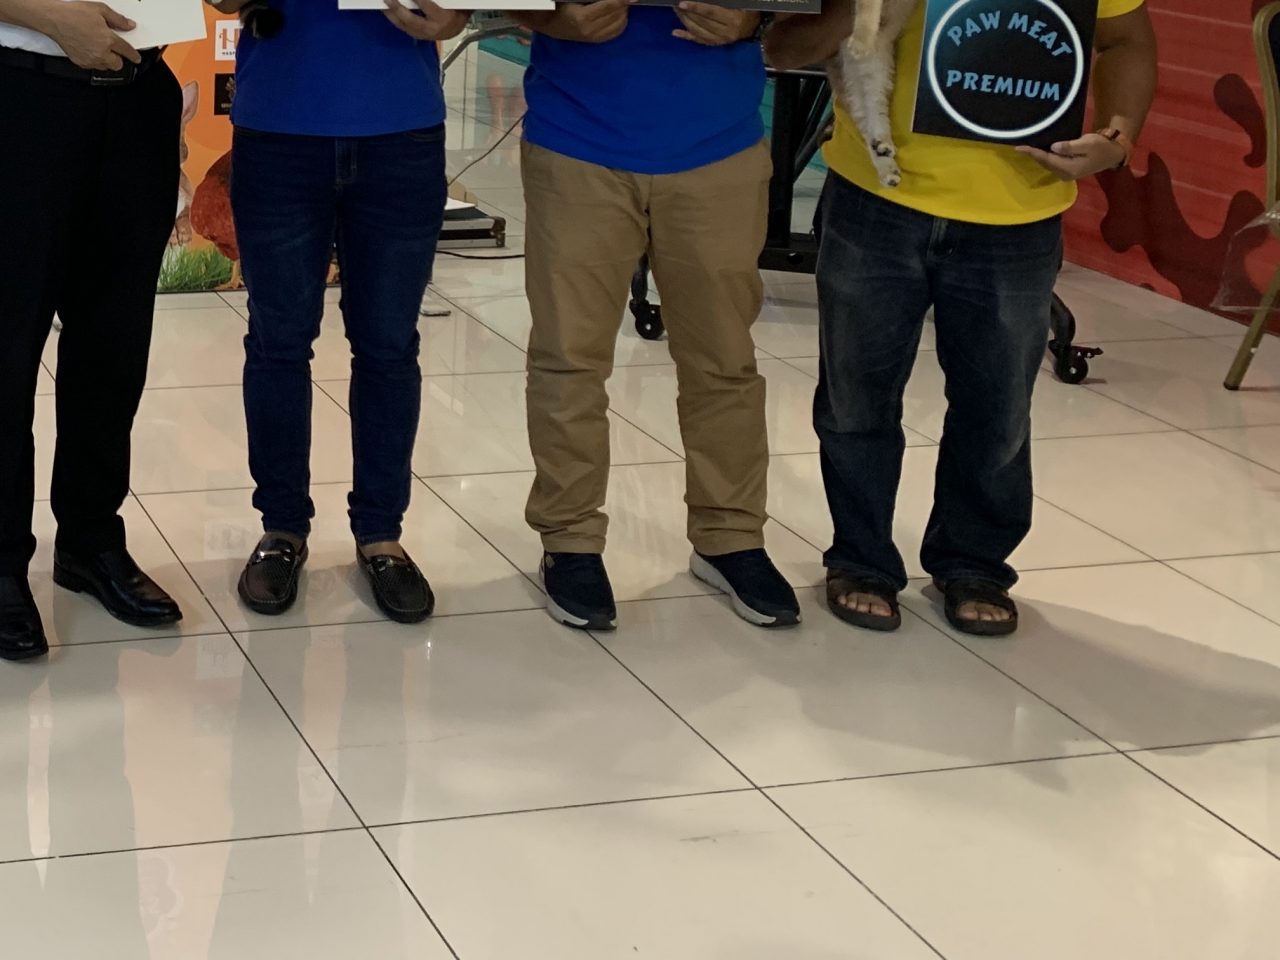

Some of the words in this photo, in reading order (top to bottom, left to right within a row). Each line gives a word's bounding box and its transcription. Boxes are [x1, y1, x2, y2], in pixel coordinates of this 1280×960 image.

[947, 10, 1001, 46] PAW
[1007, 12, 1073, 57] MEAT
[945, 69, 1060, 102] PREMIUM
